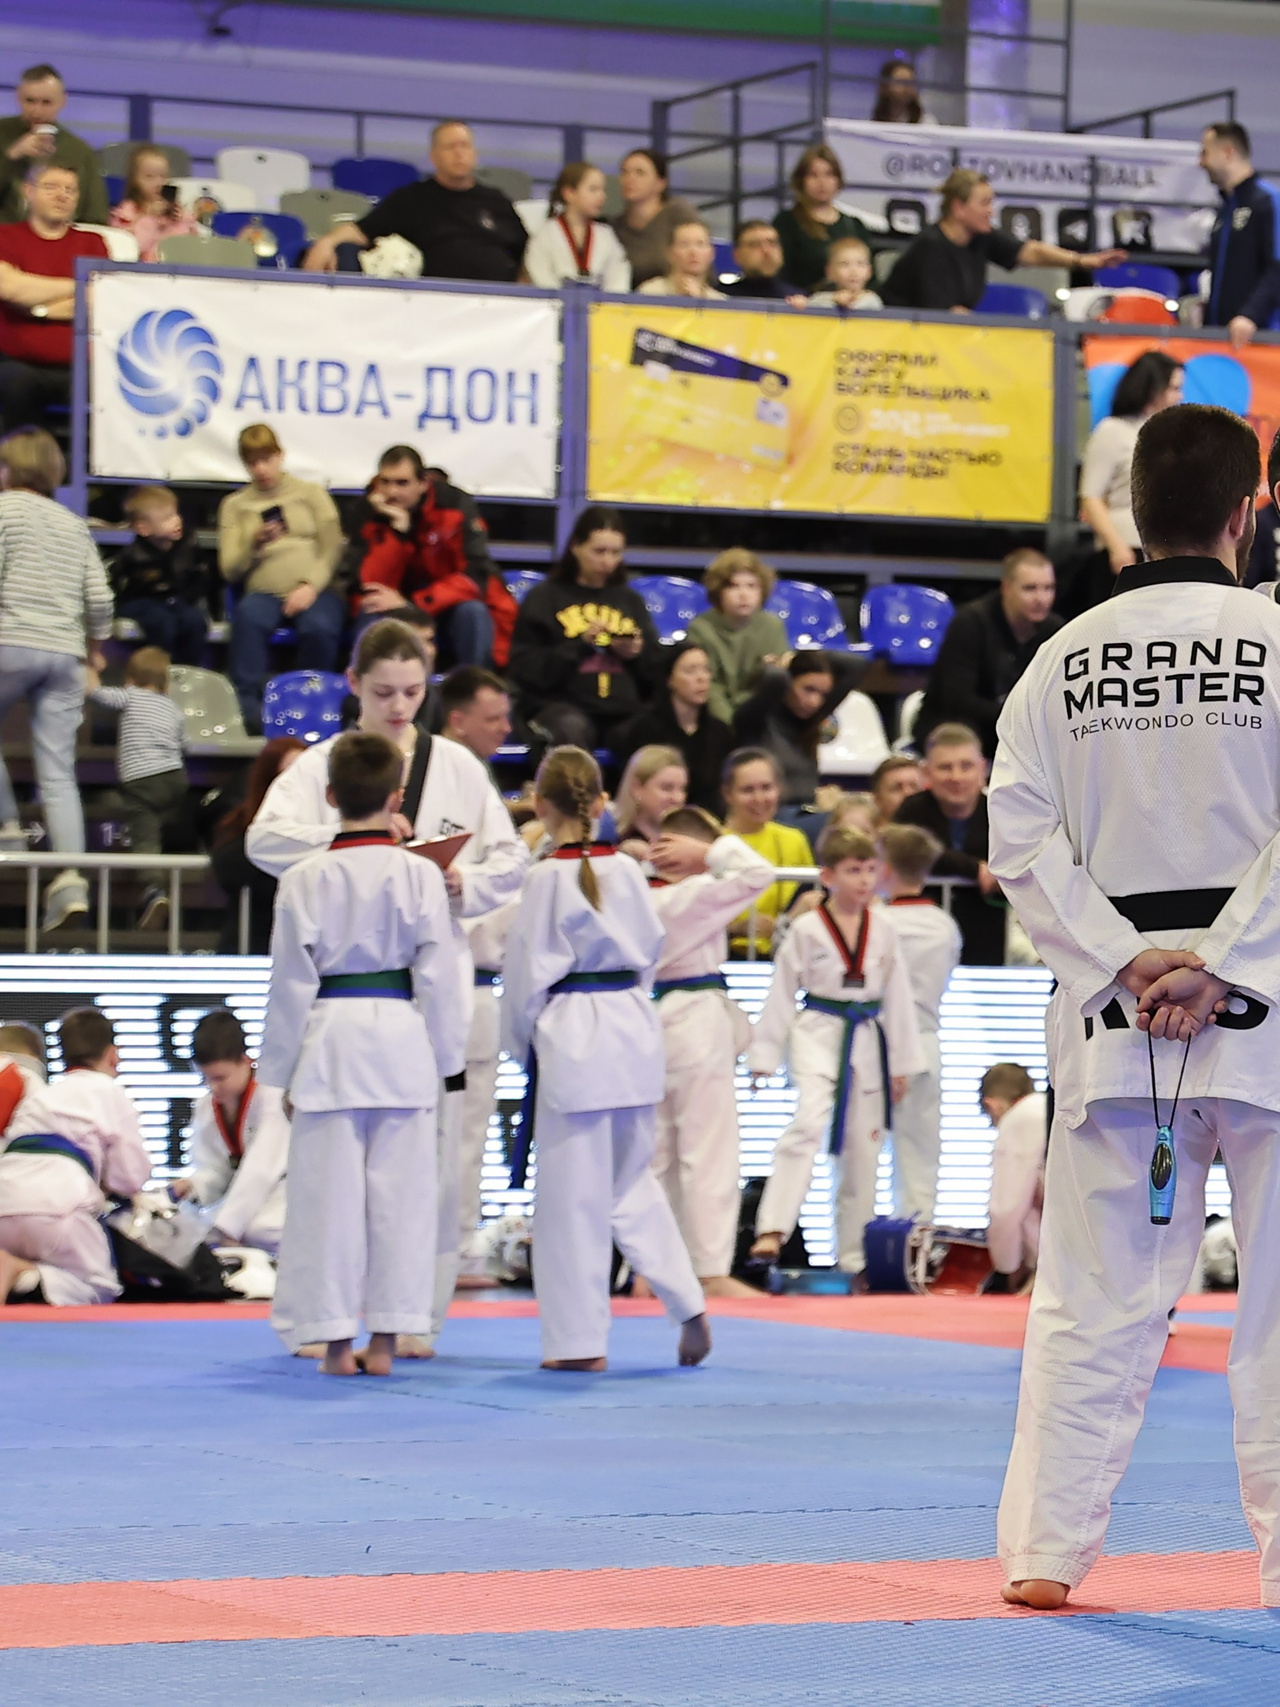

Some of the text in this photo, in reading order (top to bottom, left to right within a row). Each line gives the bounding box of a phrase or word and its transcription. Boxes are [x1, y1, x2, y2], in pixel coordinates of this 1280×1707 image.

[234, 355, 540, 432] АКВА-ДОН
[1064, 638, 1267, 681] GRAND
[1063, 672, 1265, 720] MASTER
[1069, 712, 1263, 742] TAEKWONDO CLUB
